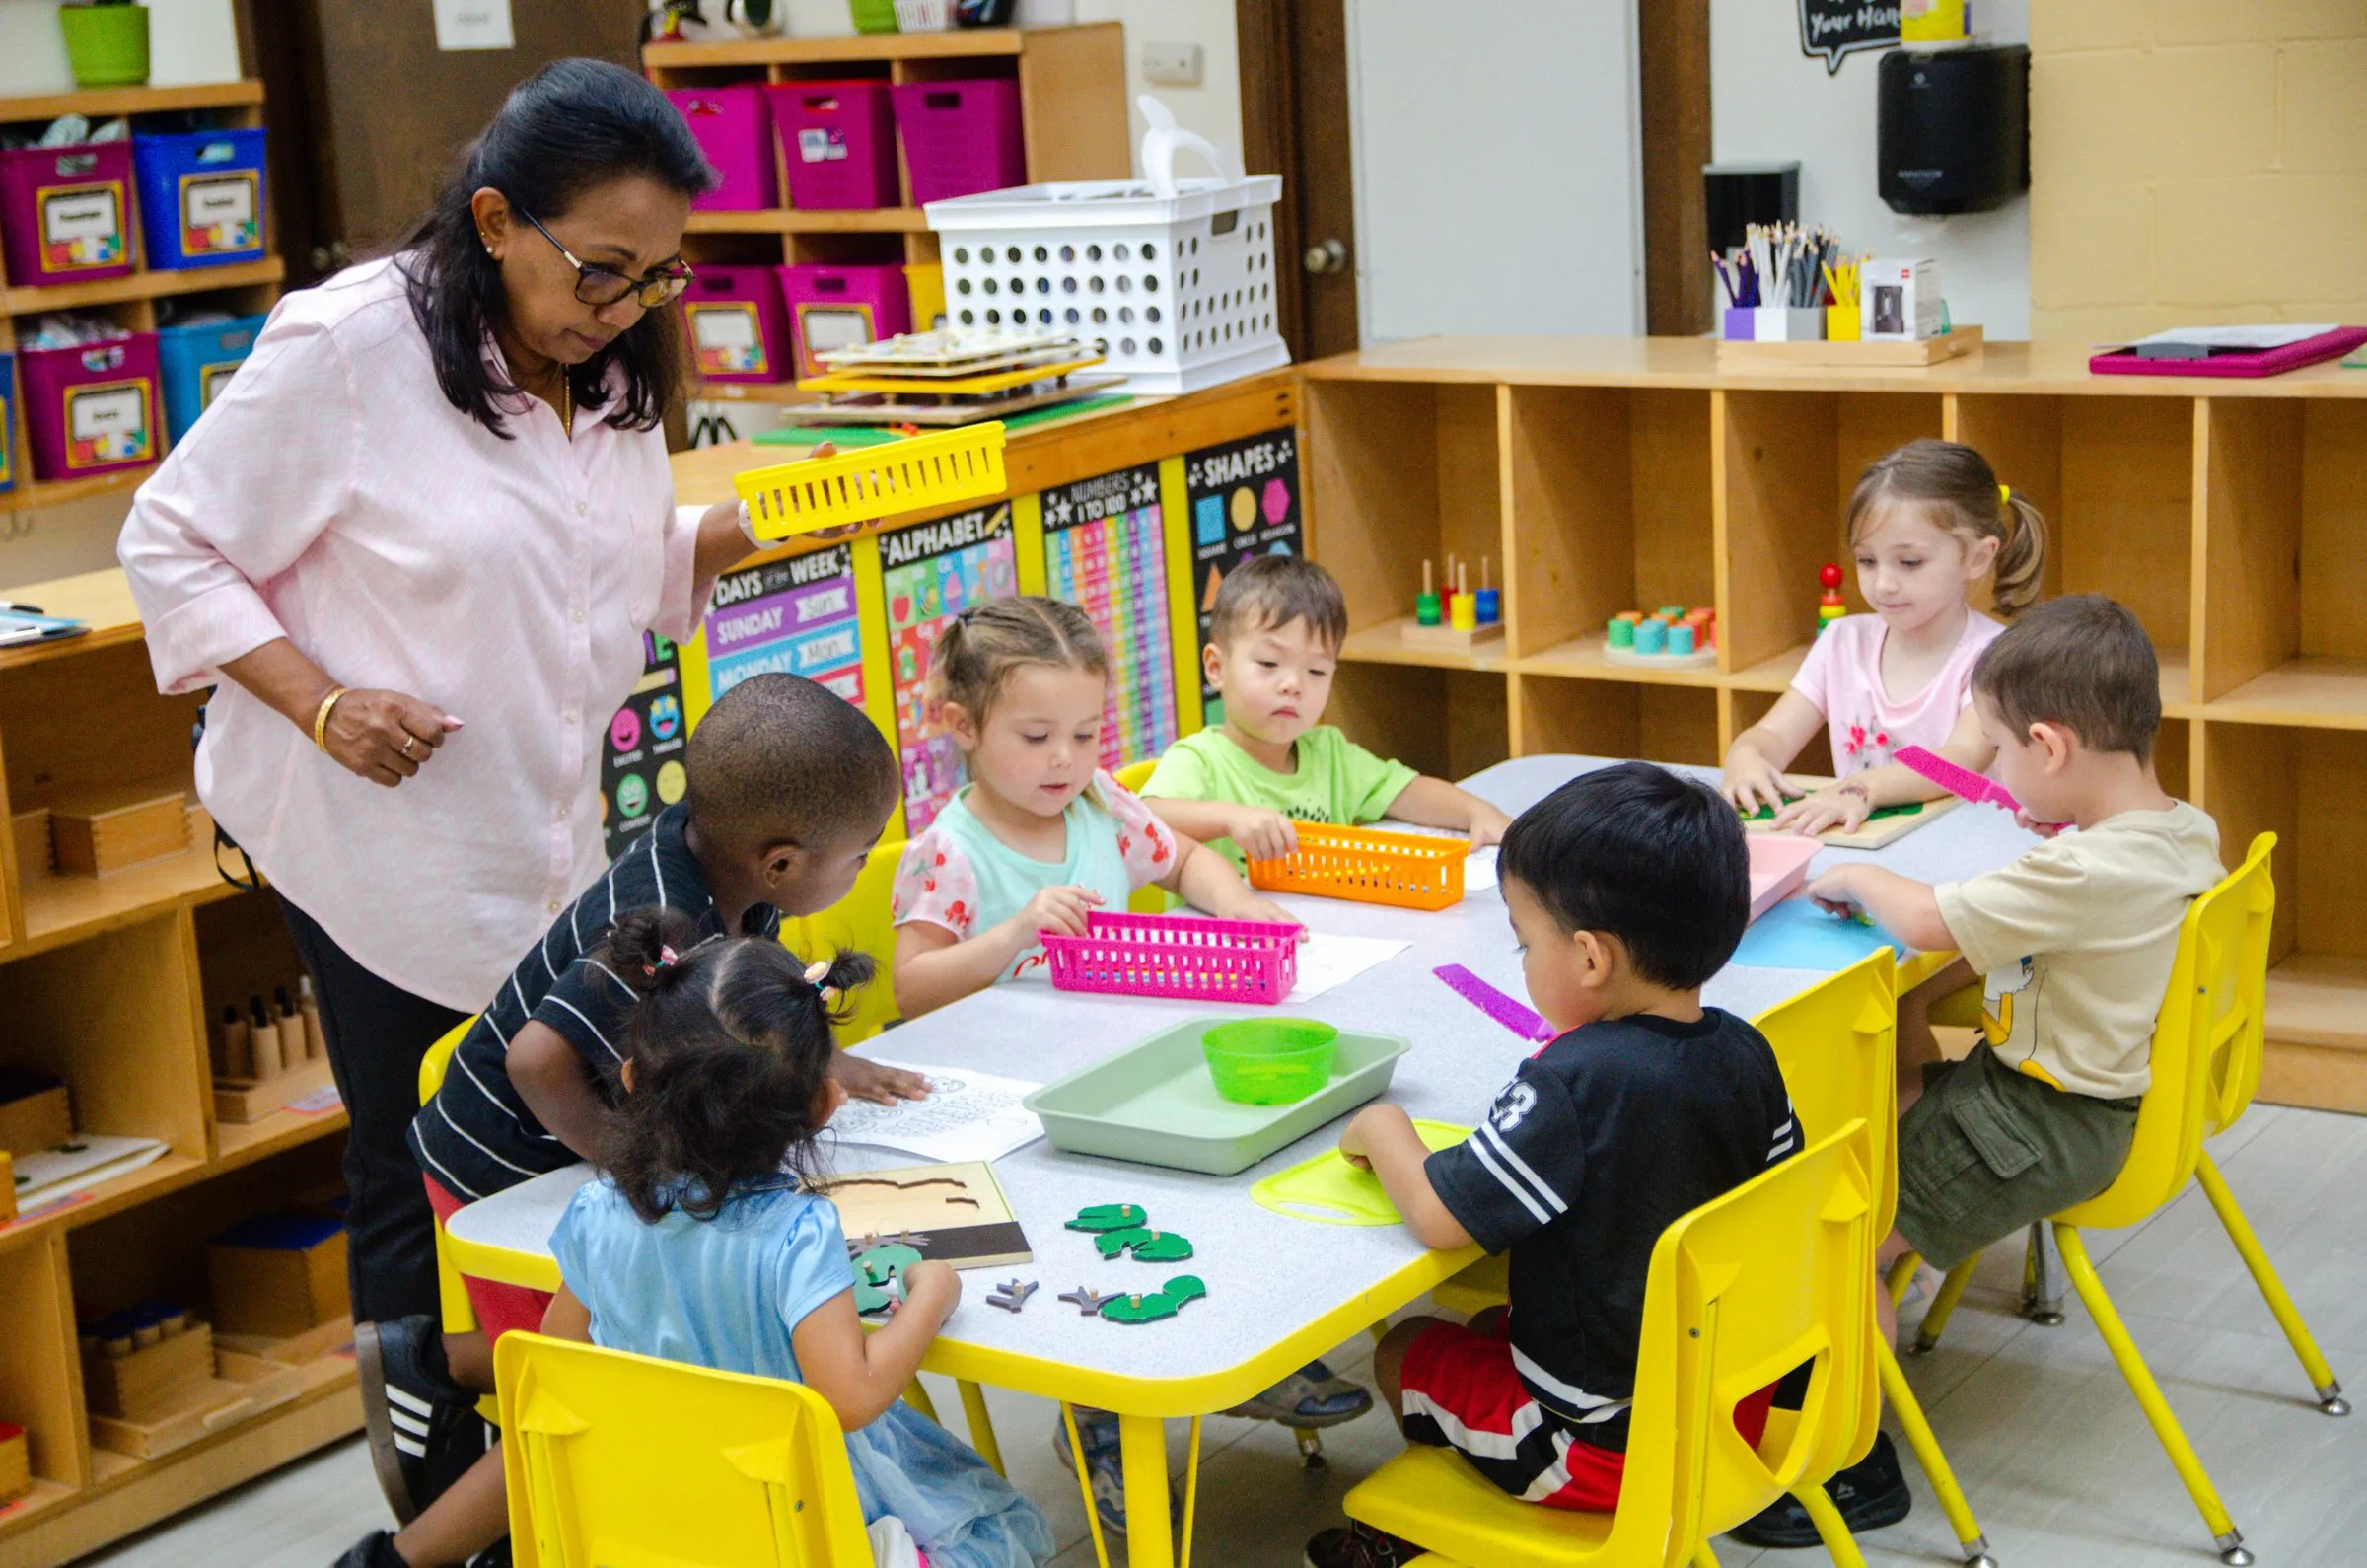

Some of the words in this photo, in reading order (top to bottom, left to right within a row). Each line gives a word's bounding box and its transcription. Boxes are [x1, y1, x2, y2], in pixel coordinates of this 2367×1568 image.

[1810, 12, 1853, 43] Your
[1204, 442, 1276, 487] SHAPES
[1071, 471, 1130, 505] NUMBERS
[1085, 499, 1104, 520] TO
[1105, 493, 1127, 516] 100
[888, 512, 986, 566] ALPHABET
[715, 572, 763, 606] DAYS
[790, 549, 839, 585] WEEK
[716, 606, 784, 645] SUNDAY
